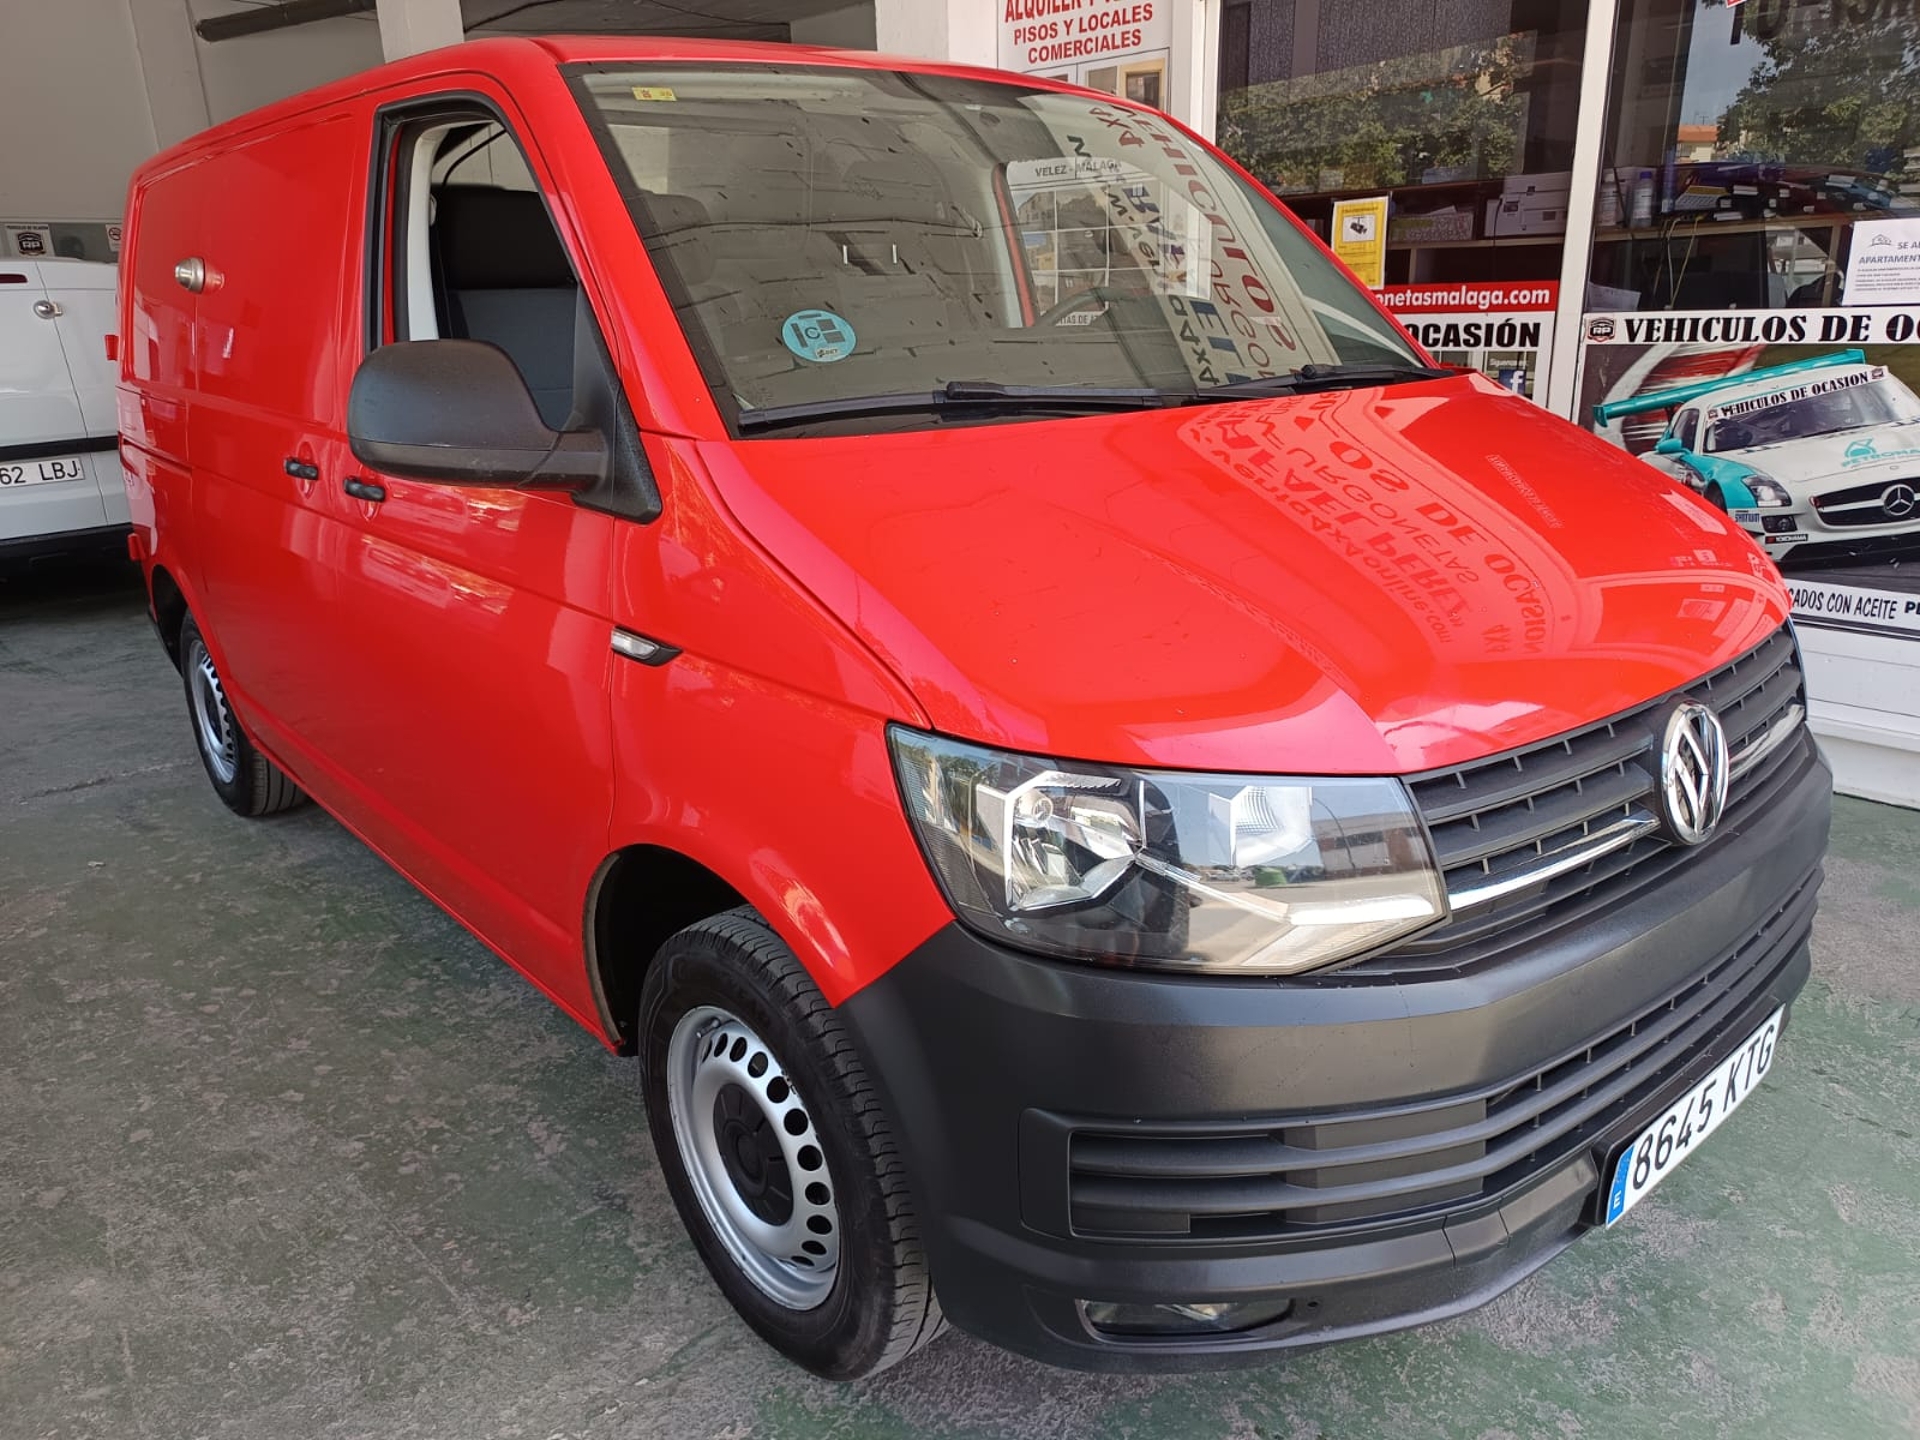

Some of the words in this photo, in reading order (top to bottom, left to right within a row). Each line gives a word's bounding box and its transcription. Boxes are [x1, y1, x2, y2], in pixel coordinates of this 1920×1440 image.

[1014, 22, 1058, 45] PISOS
[1063, 18, 1073, 36] Y
[1079, 3, 1153, 34] LOCALES
[1027, 28, 1142, 64] COMERCIALES
[1624, 315, 1807, 343] VEHICULOS
[1819, 315, 1872, 342] DE
[1885, 313, 1920, 342] O
[1720, 393, 1787, 417] VEHICULOS
[1791, 386, 1808, 401] DE
[1811, 372, 1869, 395] OCASION
[38, 460, 79, 481] LBJ
[1826, 592, 1853, 614] CON
[1853, 596, 1898, 619] ACEITE
[1632, 1078, 1718, 1190] 8645
[1722, 1024, 1775, 1113] KTG
